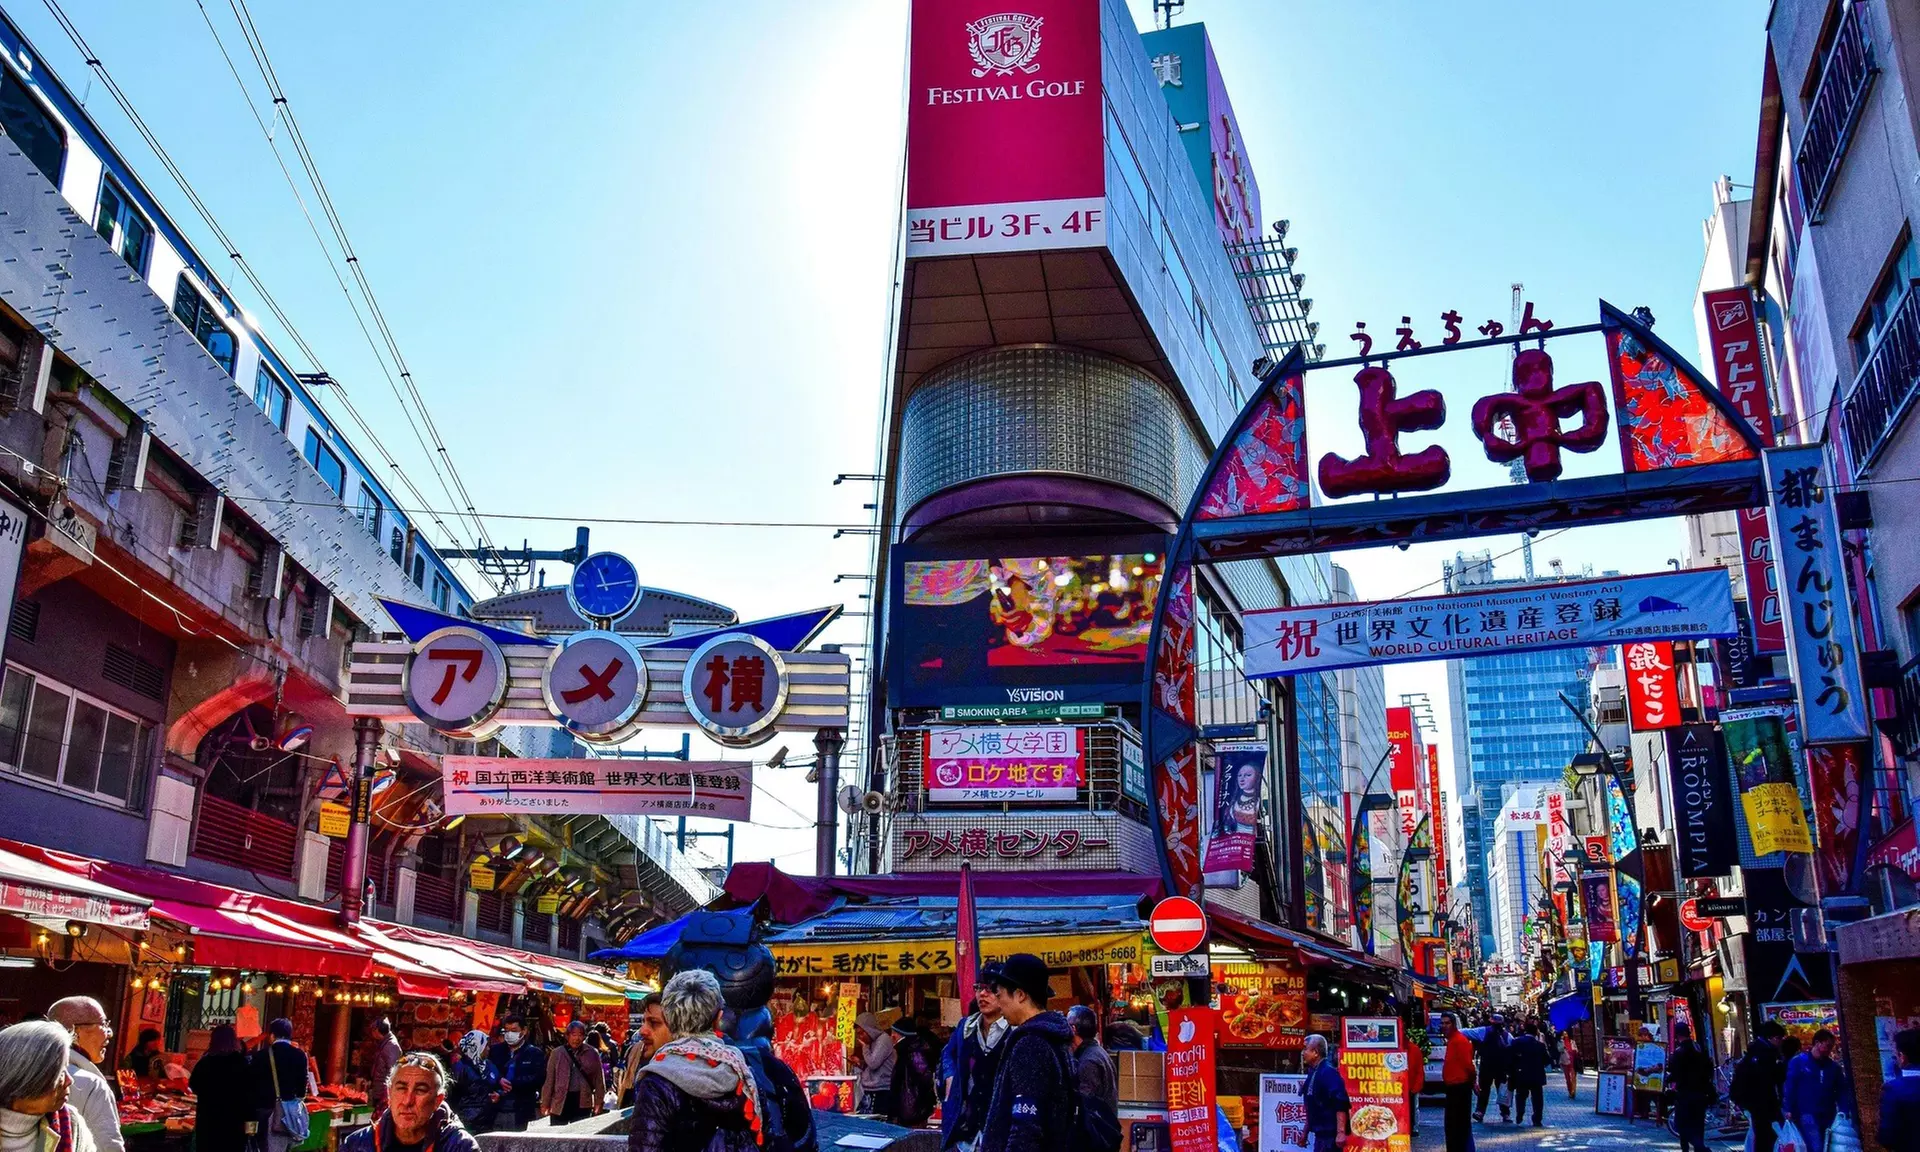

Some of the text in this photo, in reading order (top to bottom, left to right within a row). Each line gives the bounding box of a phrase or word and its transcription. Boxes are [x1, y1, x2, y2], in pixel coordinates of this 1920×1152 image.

[927, 80, 1085, 105] FESTIVAL GOLF
[910, 215, 993, 243] 当ビル
[1350, 302, 1553, 355] うえちゅん
[1318, 349, 1609, 498] 上中
[1778, 465, 1848, 716] 都まんじゅう
[1331, 607, 1403, 620] 国立西洋美術館
[1437, 597, 1483, 611] National
[1486, 595, 1531, 607] Museum
[1535, 593, 1547, 602] of
[1550, 588, 1597, 601] Western
[1276, 598, 1622, 661] 祝 世界文化遺産登録
[1370, 628, 1579, 657] WORLD CULTURAL HERITAGE
[428, 647, 766, 713] アメ横
[1627, 642, 1671, 725] 銀だこ
[957, 707, 1000, 717] SMOKING
[1002, 706, 1028, 716] AREA
[942, 731, 1067, 754] アメ横女学園
[452, 769, 741, 791] 祝 国立西洋美術館 世界文化遺産登録
[968, 764, 1068, 783] ロケ地です
[1699, 756, 1713, 811] ルームピア
[479, 797, 569, 807] ありがとうございました
[641, 800, 716, 811] アメ横商店街連合会
[962, 790, 1044, 799] アメ横センタービル
[1510, 810, 1542, 821] 松坂屋
[1681, 757, 1709, 872] ROOMPIA
[902, 827, 1109, 859] アメ横センター
[832, 952, 889, 972] 毛がに
[899, 950, 952, 970] まぐろ
[1224, 963, 1264, 975] JUMBO
[1341, 1052, 1385, 1065] JUMBO
[1347, 1066, 1392, 1080] DONER
[1265, 1080, 1292, 1094] iPhone
[1360, 1081, 1403, 1095] KEBAB
[1381, 1096, 1404, 1104] KEBAB
